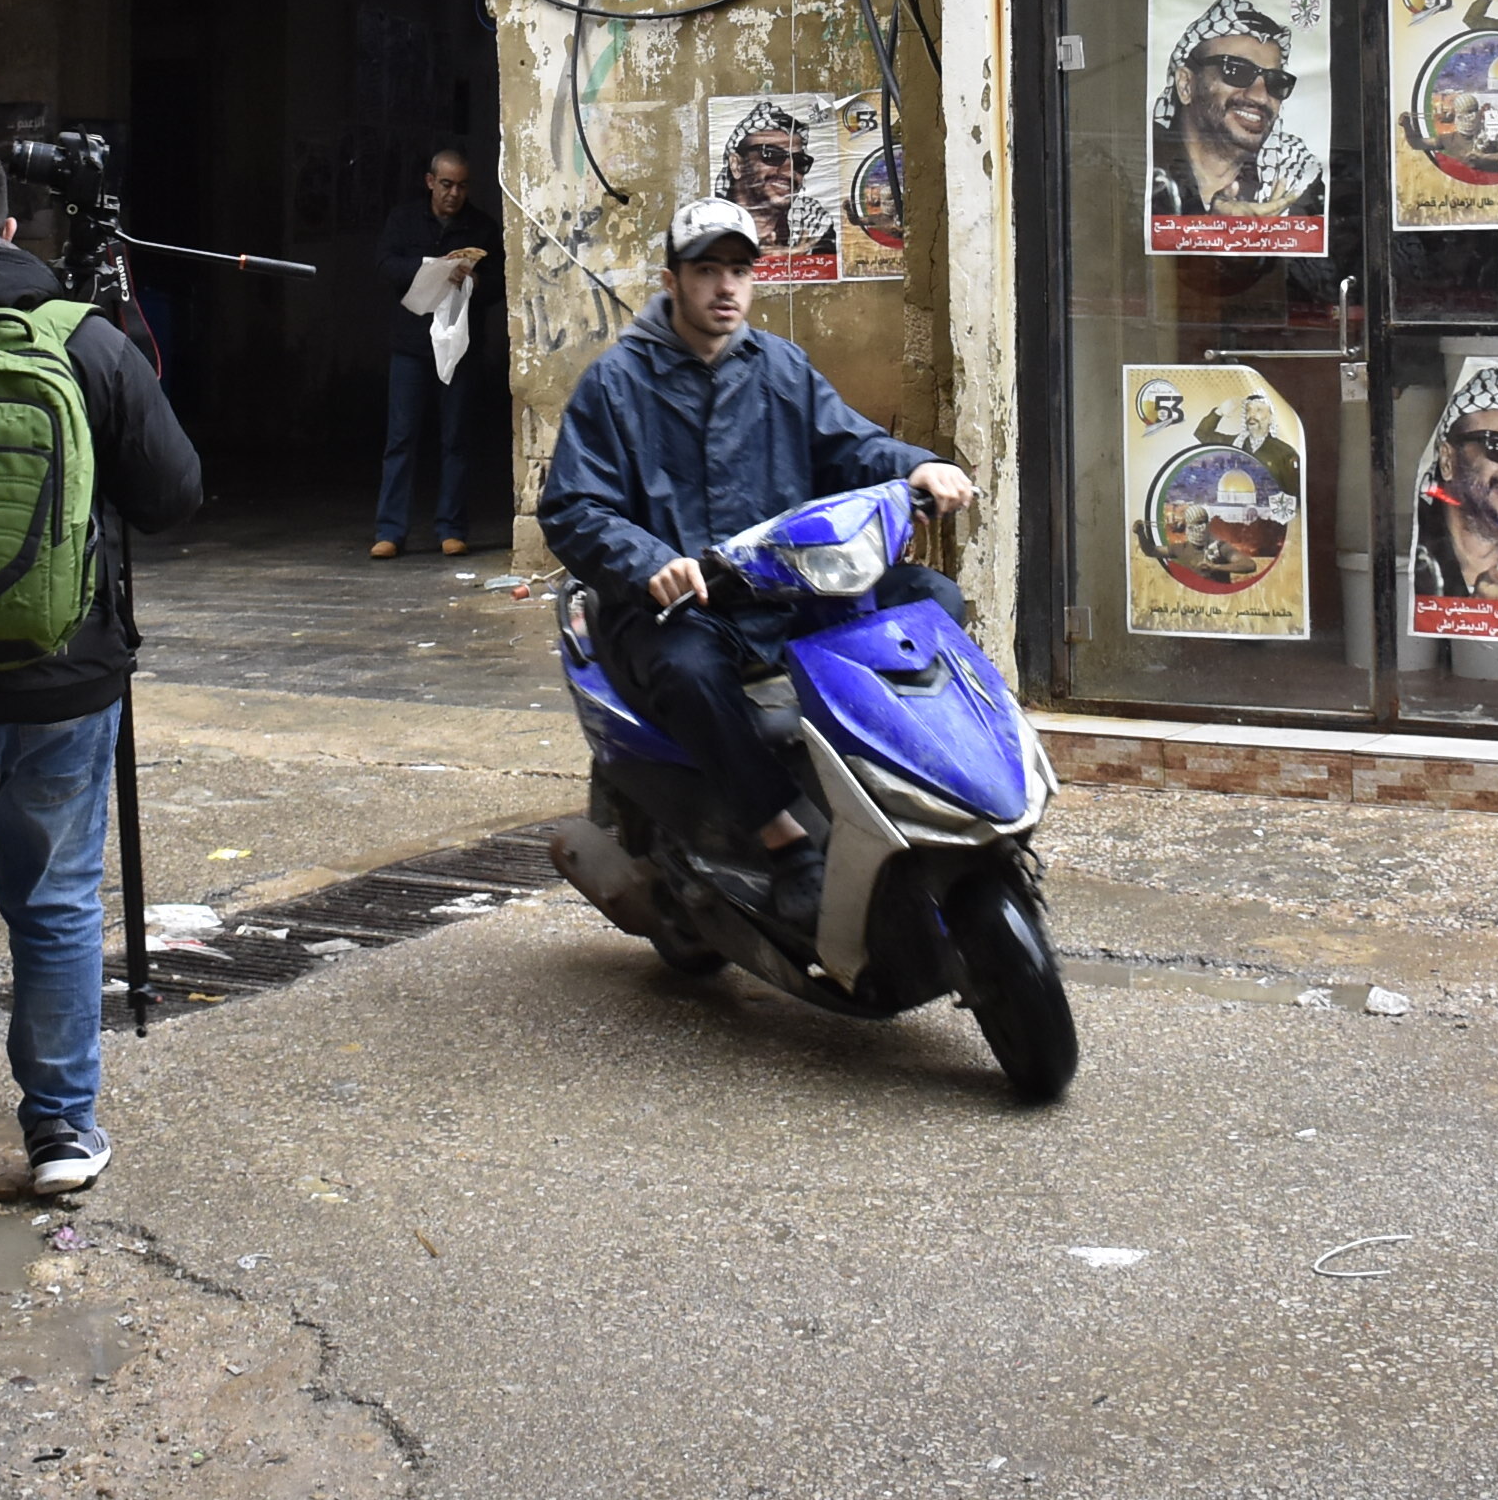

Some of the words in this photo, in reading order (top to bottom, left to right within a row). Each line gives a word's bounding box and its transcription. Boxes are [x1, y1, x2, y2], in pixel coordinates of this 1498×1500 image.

[1154, 220, 1176, 232] فتح
[1183, 220, 1227, 233] الفلسطيني
[1228, 220, 1258, 234] الوطني
[1260, 220, 1291, 232] التحرير
[1294, 220, 1319, 233] حركة
[1175, 236, 1223, 250] الديمقراطي
[1224, 237, 1271, 250] الإصلاحي
[1273, 237, 1298, 250] التيار
[115, 255, 130, 302] Canon
[1155, 396, 1184, 425] 53
[1417, 600, 1438, 613] فتح
[1445, 602, 1493, 616] الفلسطيني
[1436, 619, 1488, 633] الديمقراطي
